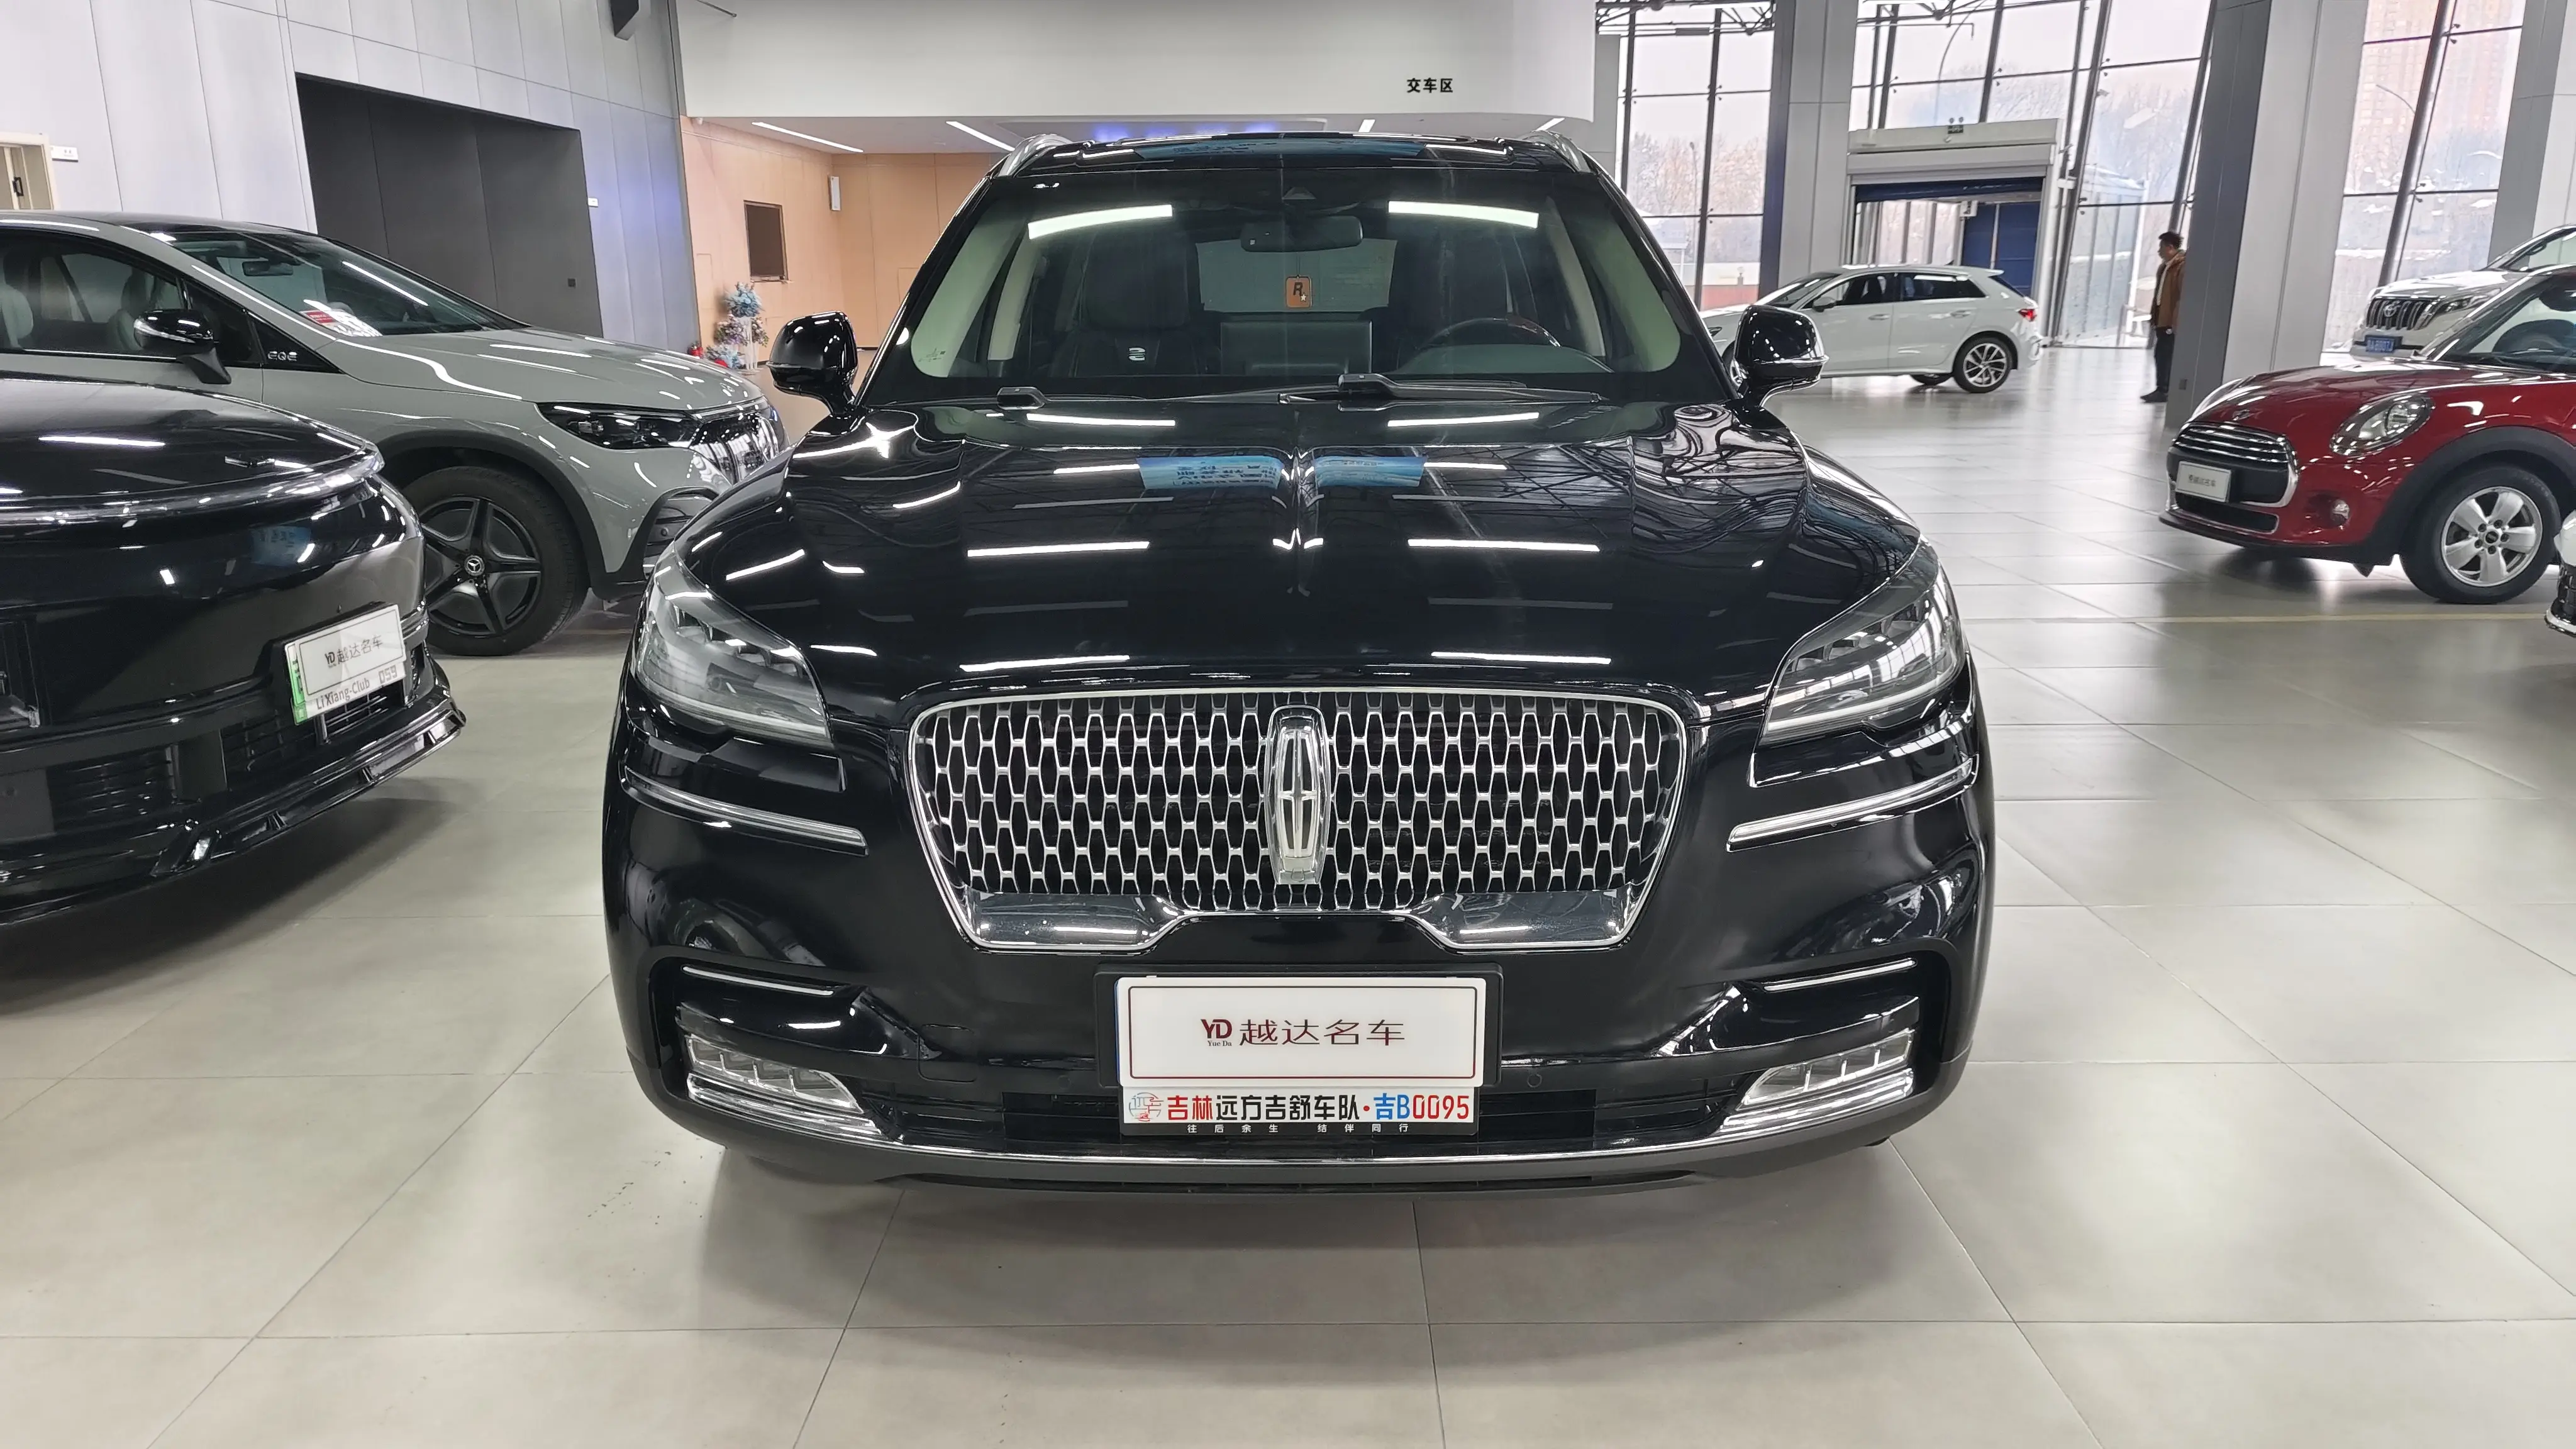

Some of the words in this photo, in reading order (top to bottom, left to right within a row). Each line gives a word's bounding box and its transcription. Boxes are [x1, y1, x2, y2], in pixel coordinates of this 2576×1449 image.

[1406, 77, 1453, 94] 交车区
[267, 351, 297, 362] EQE
[336, 634, 383, 665] 越达名车
[325, 652, 336, 665] YD
[1201, 1018, 1233, 1038] YD
[1239, 1018, 1405, 1046] 越达名车
[1187, 1123, 1279, 1133] 往后余生
[1317, 1123, 1409, 1133] 结伴同行
